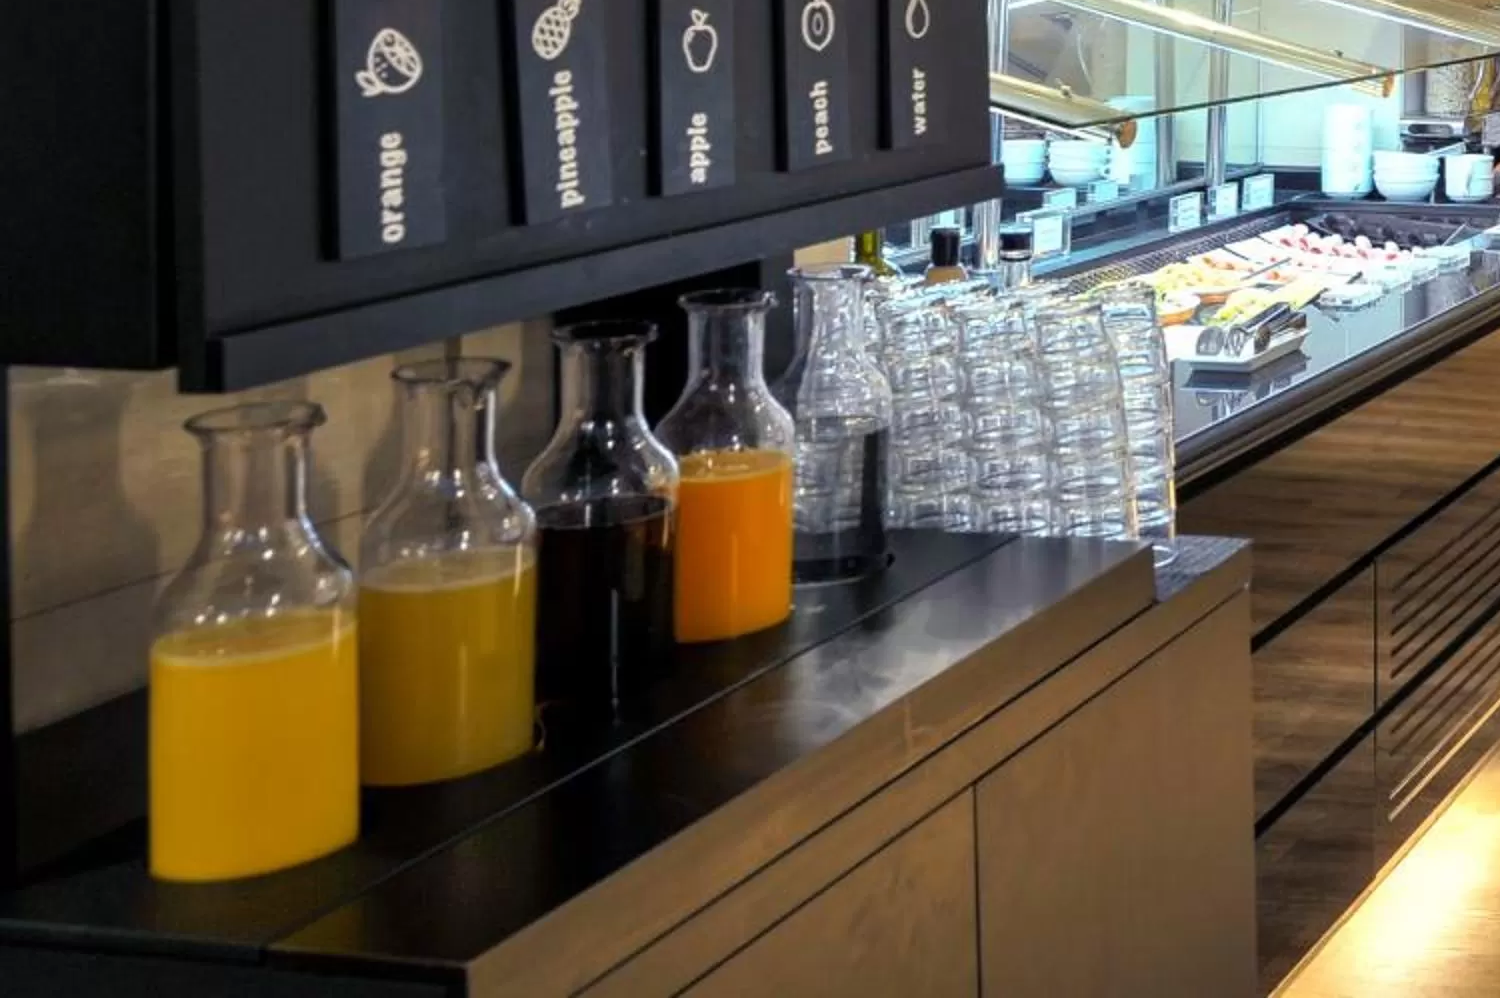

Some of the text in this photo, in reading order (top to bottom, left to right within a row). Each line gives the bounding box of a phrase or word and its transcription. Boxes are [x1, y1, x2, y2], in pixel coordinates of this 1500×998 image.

[809, 80, 833, 155] peach
[911, 67, 927, 135] water
[549, 69, 585, 209] pineapple
[686, 112, 713, 184] apple
[379, 131, 408, 244] orange
